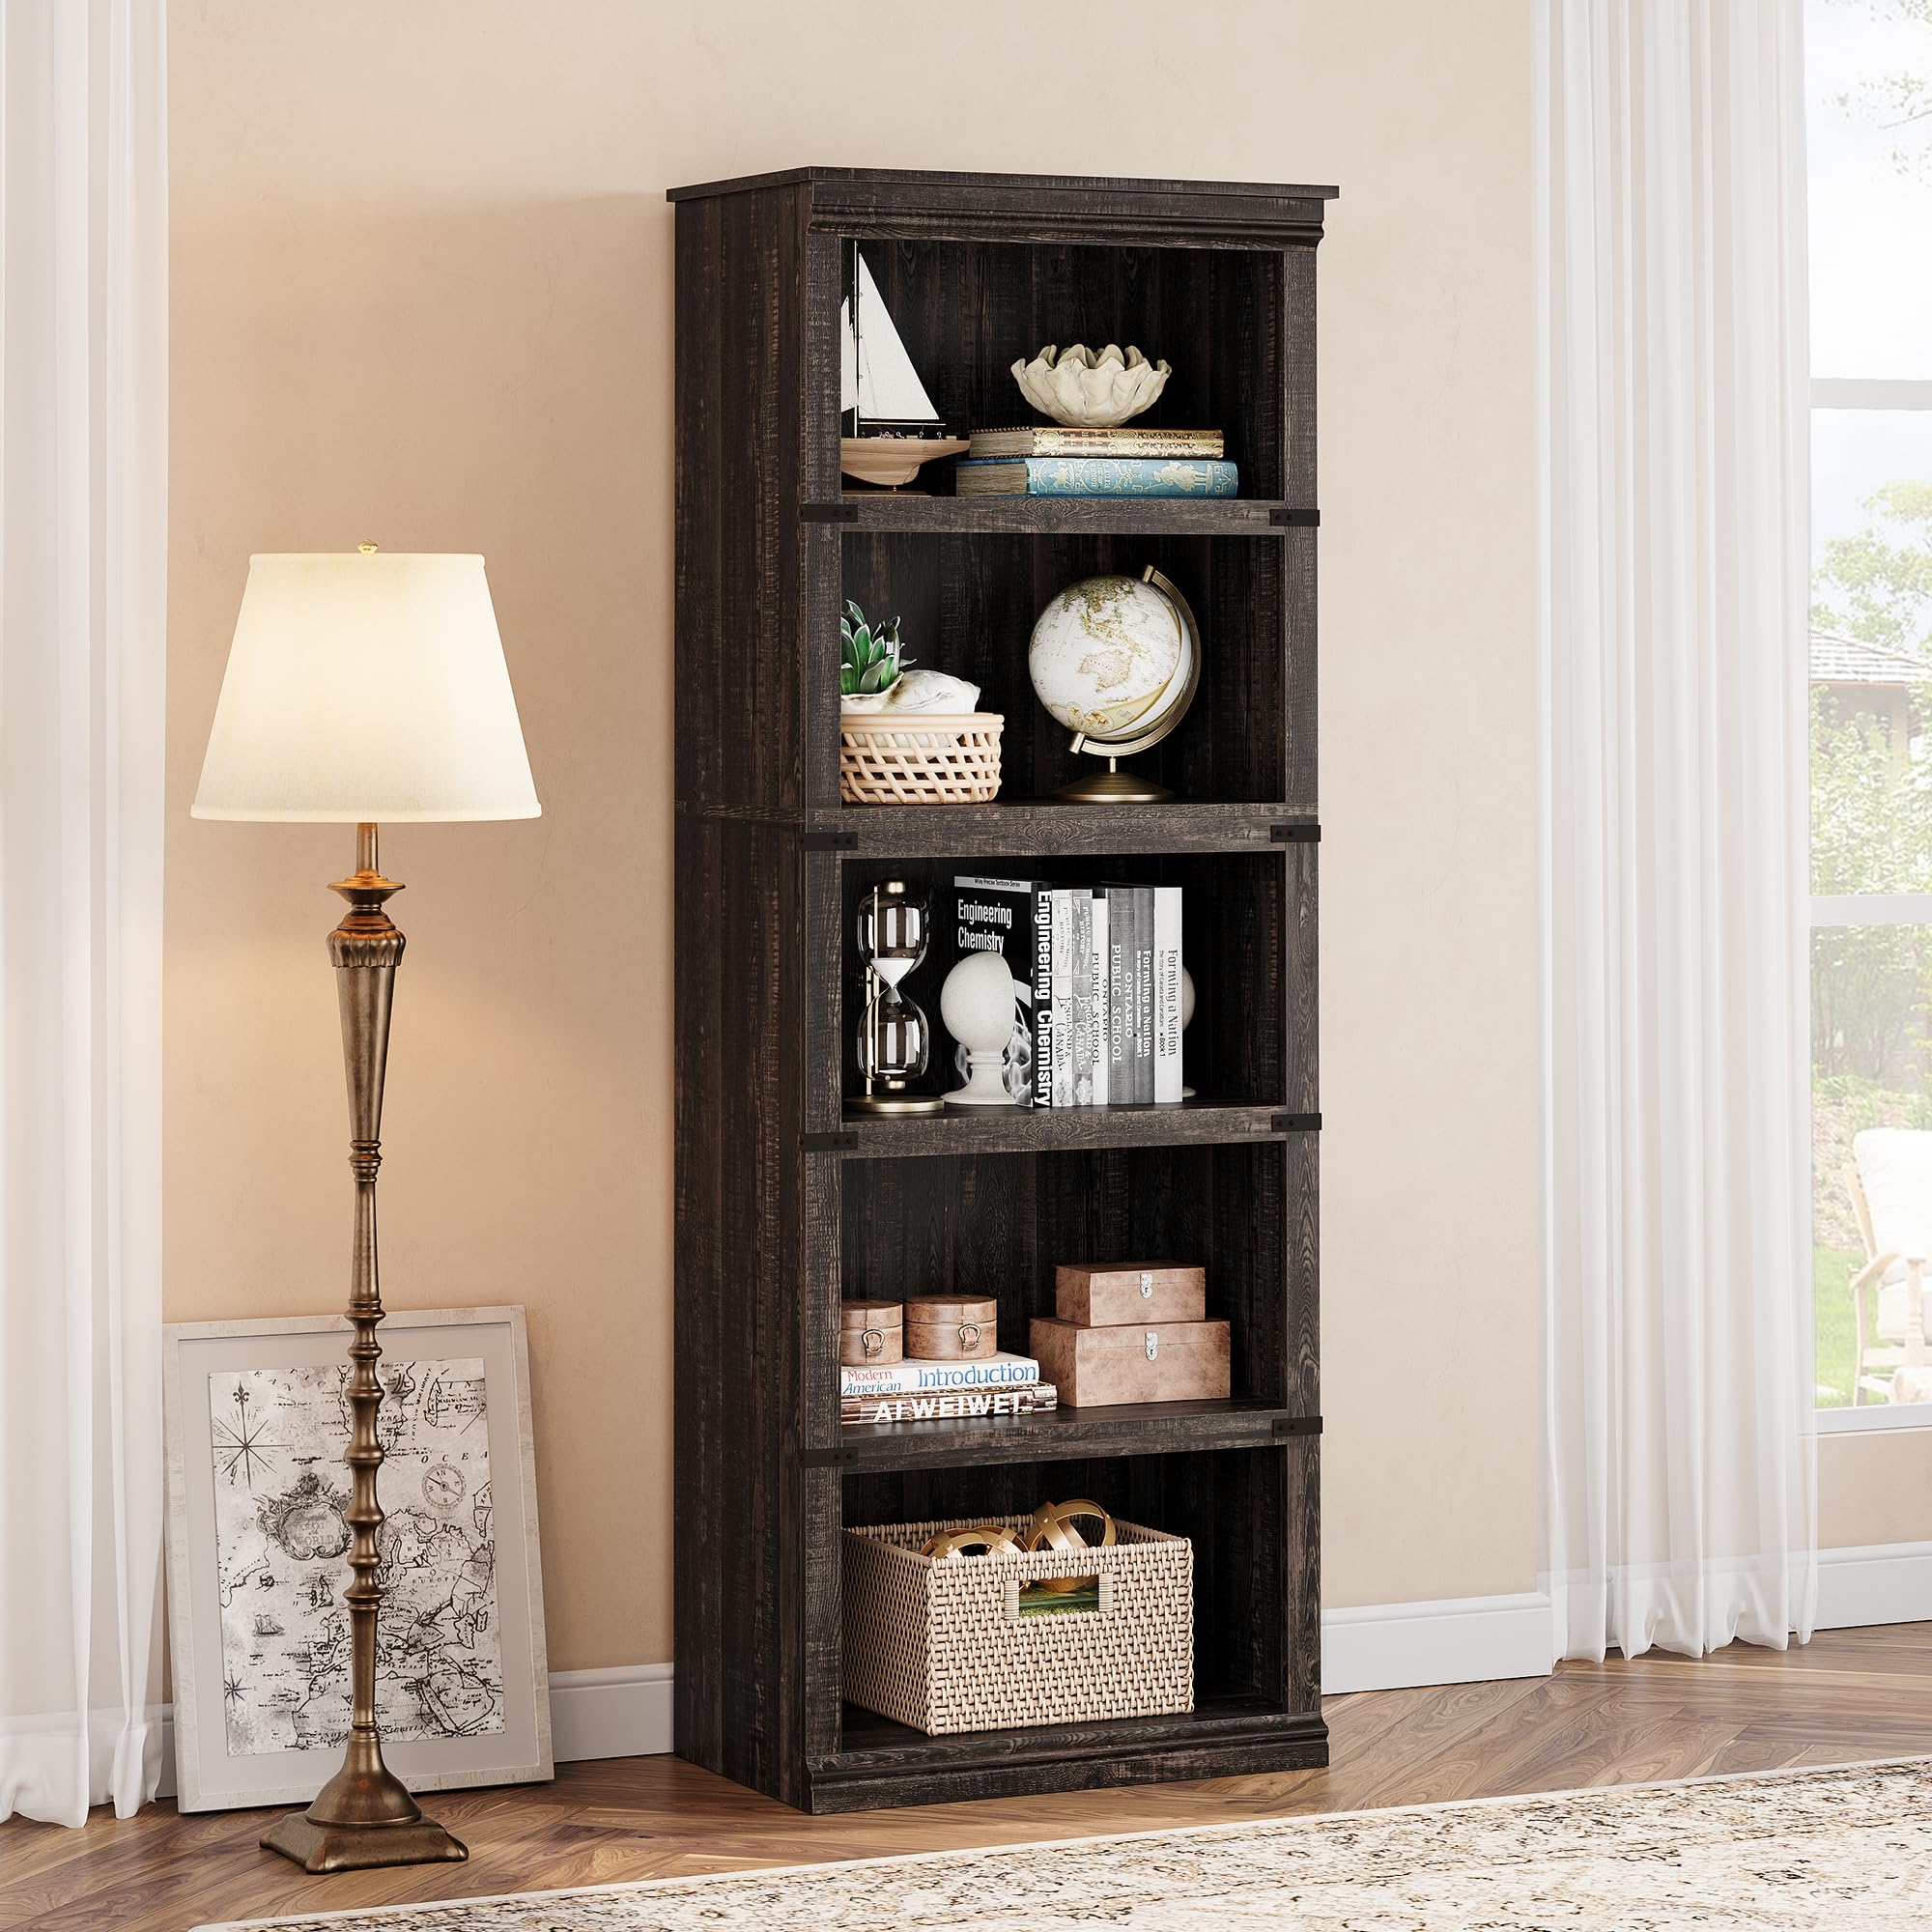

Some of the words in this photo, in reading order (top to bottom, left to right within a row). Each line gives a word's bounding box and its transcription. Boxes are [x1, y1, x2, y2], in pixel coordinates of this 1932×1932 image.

[957, 898, 1012, 929] Engineering
[1082, 905, 1092, 934] PUBLIC
[957, 925, 1005, 956] Chemistry
[1034, 891, 1053, 1001] Engineering
[1082, 937, 1092, 969] SCHOOL
[1112, 944, 1122, 997] PUBLIC
[1142, 950, 1151, 1004] Forming
[1166, 950, 1179, 1003] Forming
[1124, 972, 1133, 1038] ONTARIO
[1167, 1005, 1177, 1013] a
[1054, 994, 1071, 1050] ENGLAND
[1065, 1050, 1071, 1059] &
[1074, 994, 1093, 1049] ENGLAND
[1084, 1050, 1092, 1059] &
[1092, 1010, 1100, 1066] SCHOOL
[1112, 1006, 1122, 1065] SCHOOL
[1143, 1015, 1151, 1058] Nation
[1167, 1015, 1179, 1057] Nation
[1034, 1009, 1053, 1107] Chemistry
[842, 1380, 901, 1395] American
[847, 1369, 893, 1382] Modern
[917, 1362, 1037, 1388] Introduction
[291, 1535, 334, 1546] WORLD
[412, 1575, 458, 1585] EUROPE
